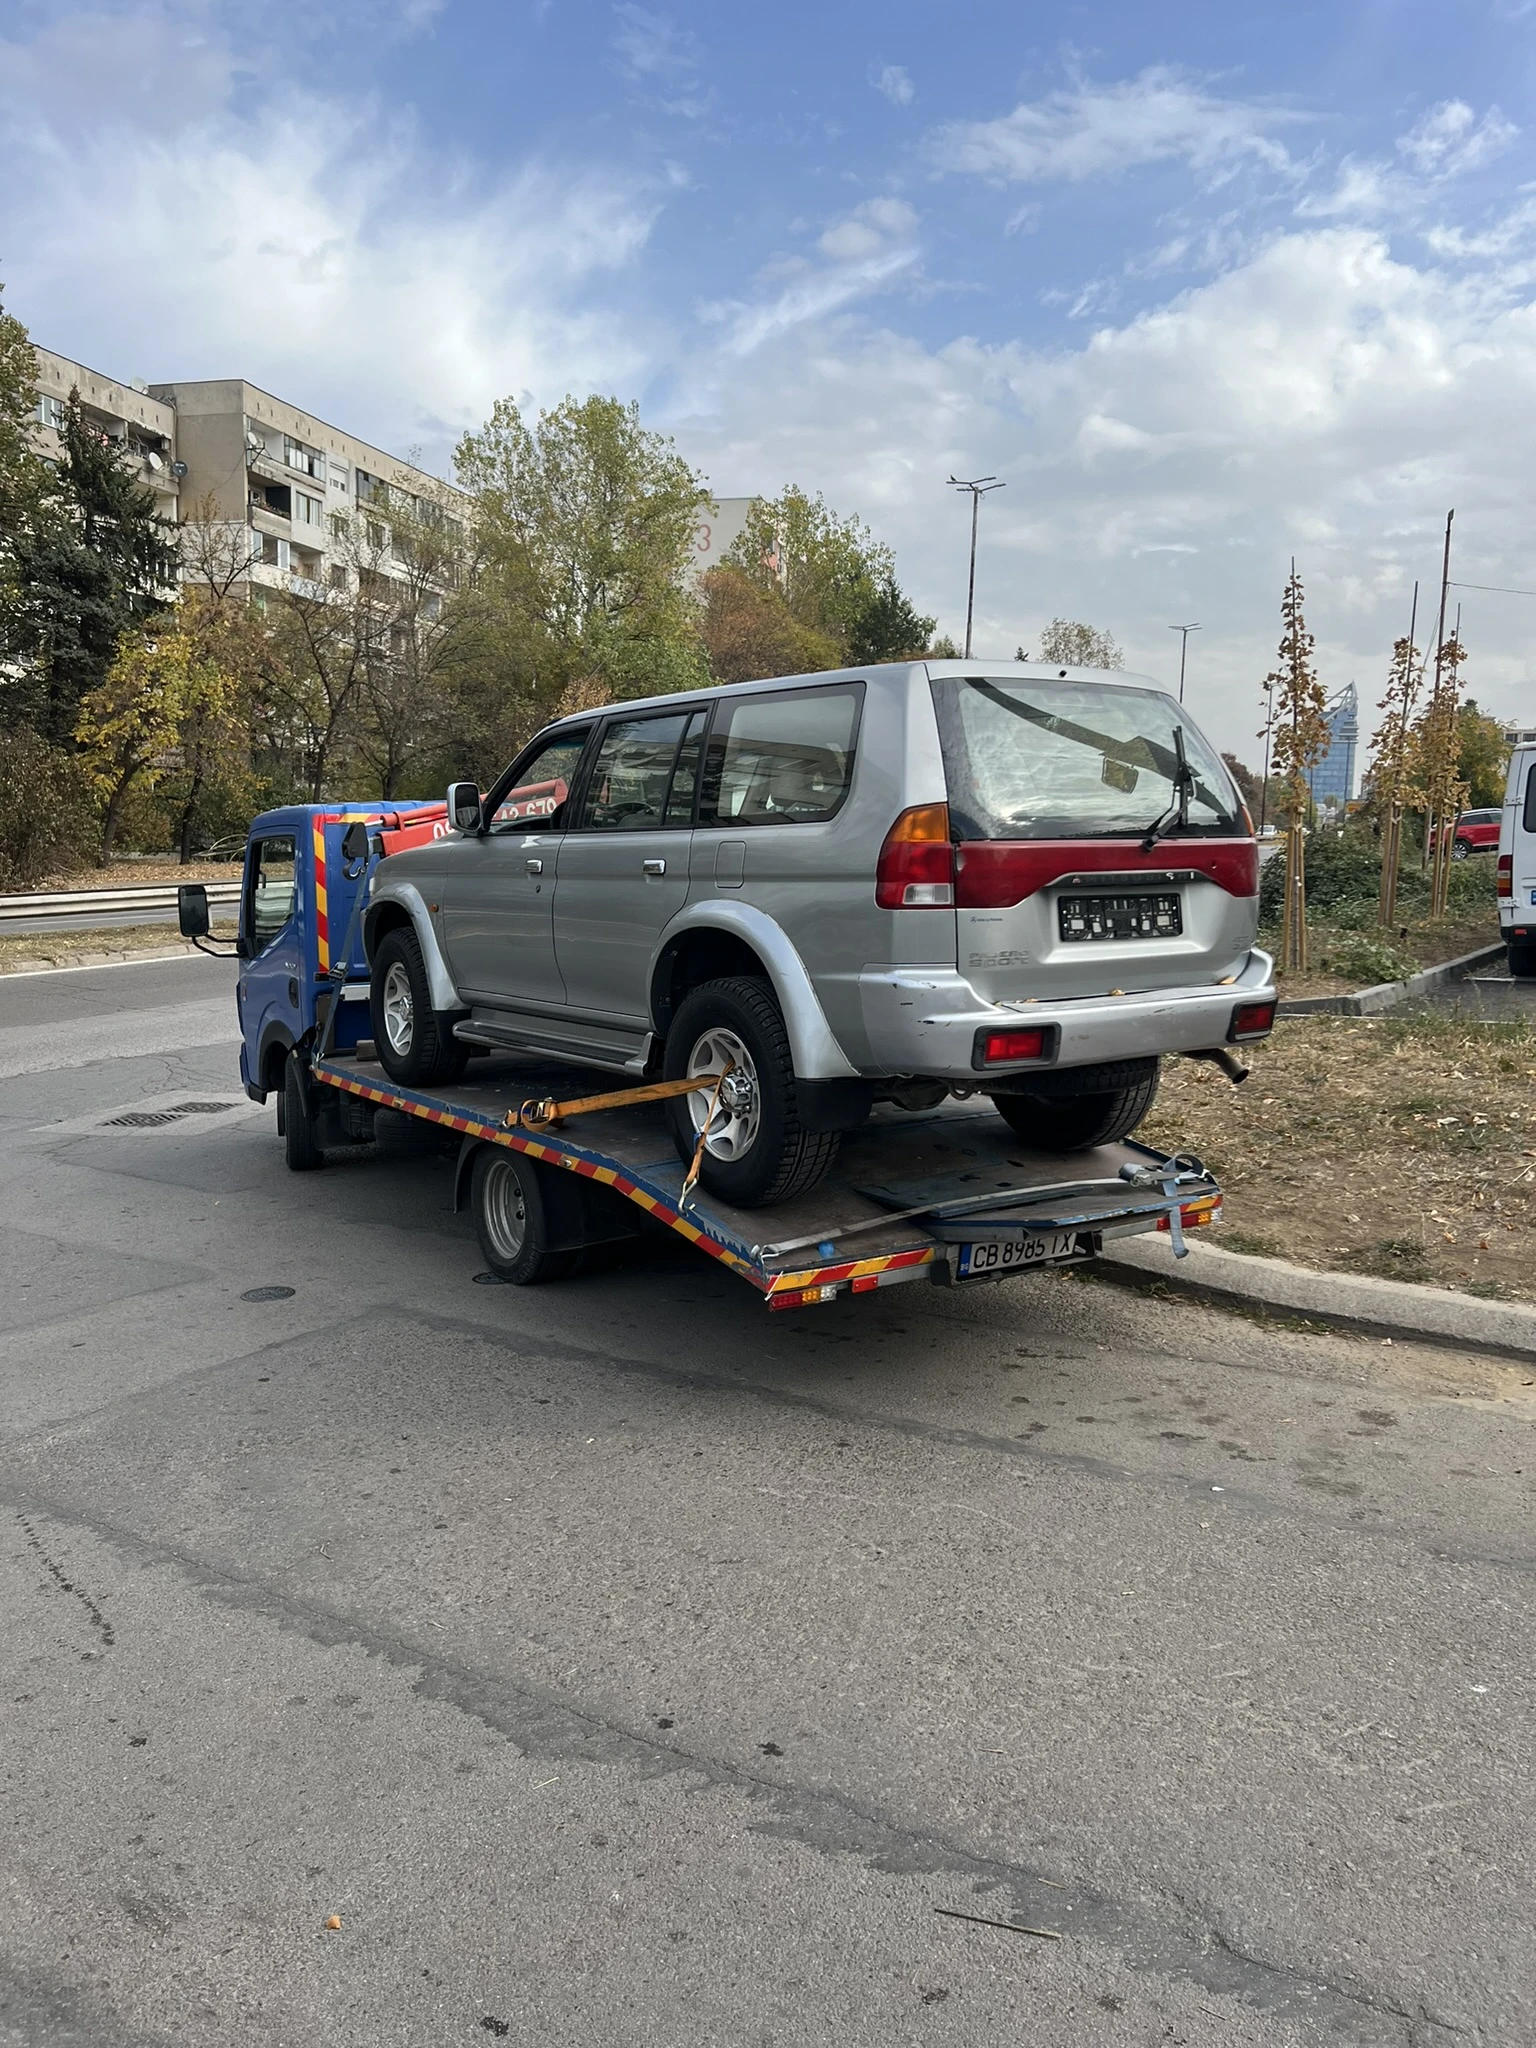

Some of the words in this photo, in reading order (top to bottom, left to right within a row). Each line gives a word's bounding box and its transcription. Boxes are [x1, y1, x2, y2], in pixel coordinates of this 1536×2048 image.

[1085, 871, 1196, 883] MITSUBISHI
[968, 950, 1030, 960] PAJERO
[973, 1243, 999, 1269] CB
[1002, 1238, 1045, 1264] 8985
